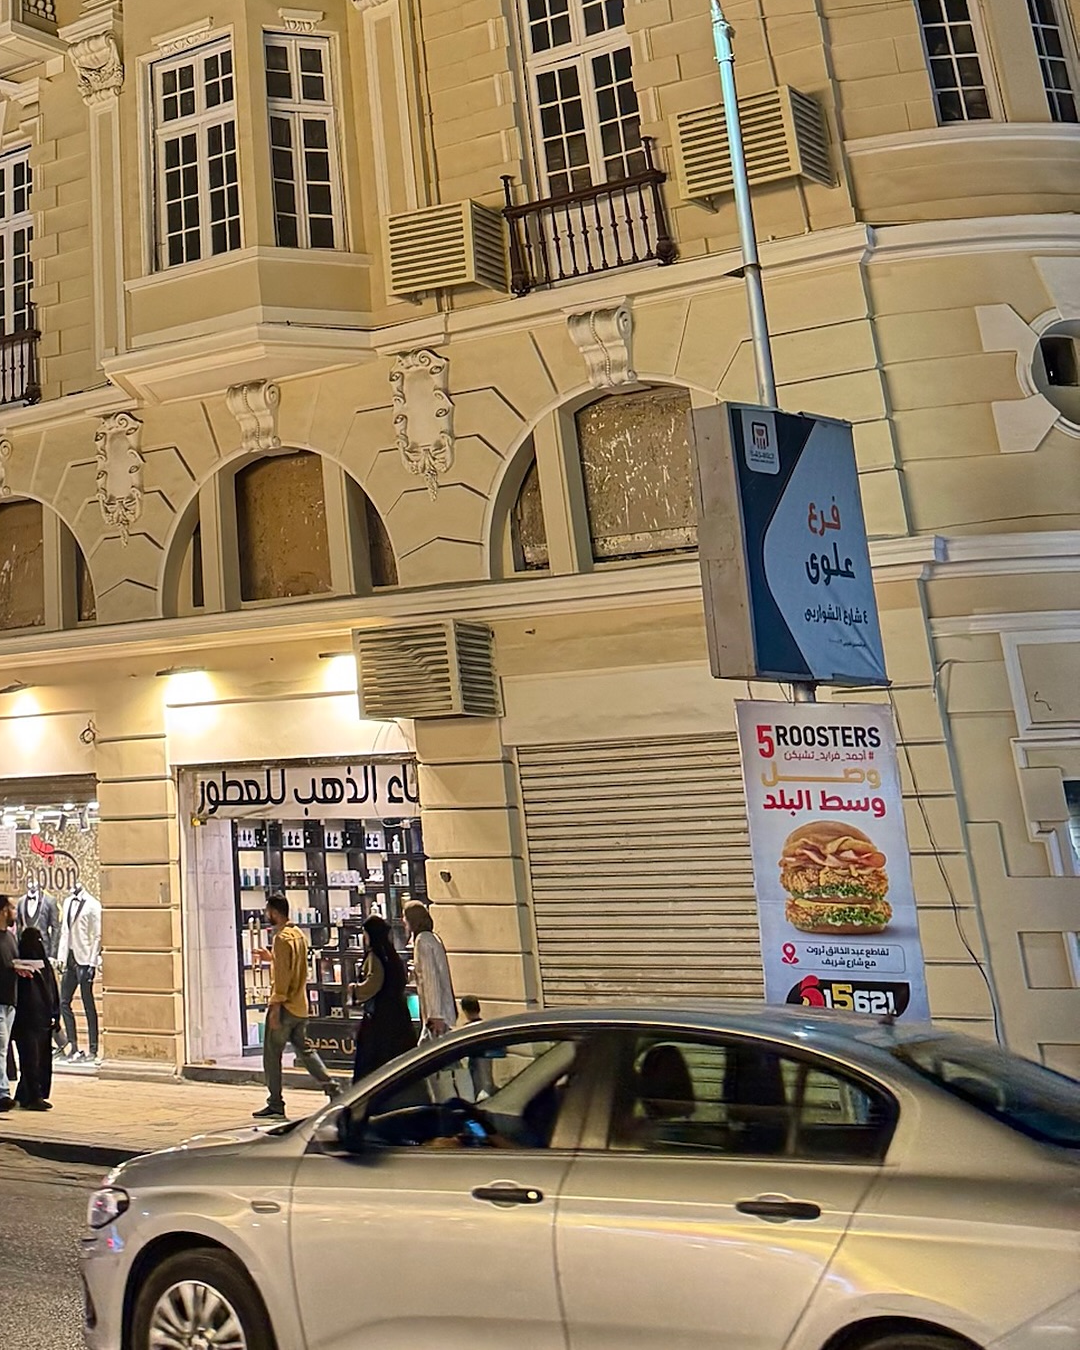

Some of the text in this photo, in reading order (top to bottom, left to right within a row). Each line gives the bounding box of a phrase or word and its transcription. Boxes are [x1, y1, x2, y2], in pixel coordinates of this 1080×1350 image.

[807, 496, 841, 536] فرع
[844, 607, 863, 626] شارع
[756, 725, 881, 758] 5 ROOSTERS
[197, 768, 286, 814] للعطور
[294, 765, 378, 816] الذهب
[763, 789, 887, 818] وسط البلد
[821, 957, 877, 969] مع شارع شريف
[851, 947, 865, 957] عبد
[823, 983, 897, 1015] 15621
